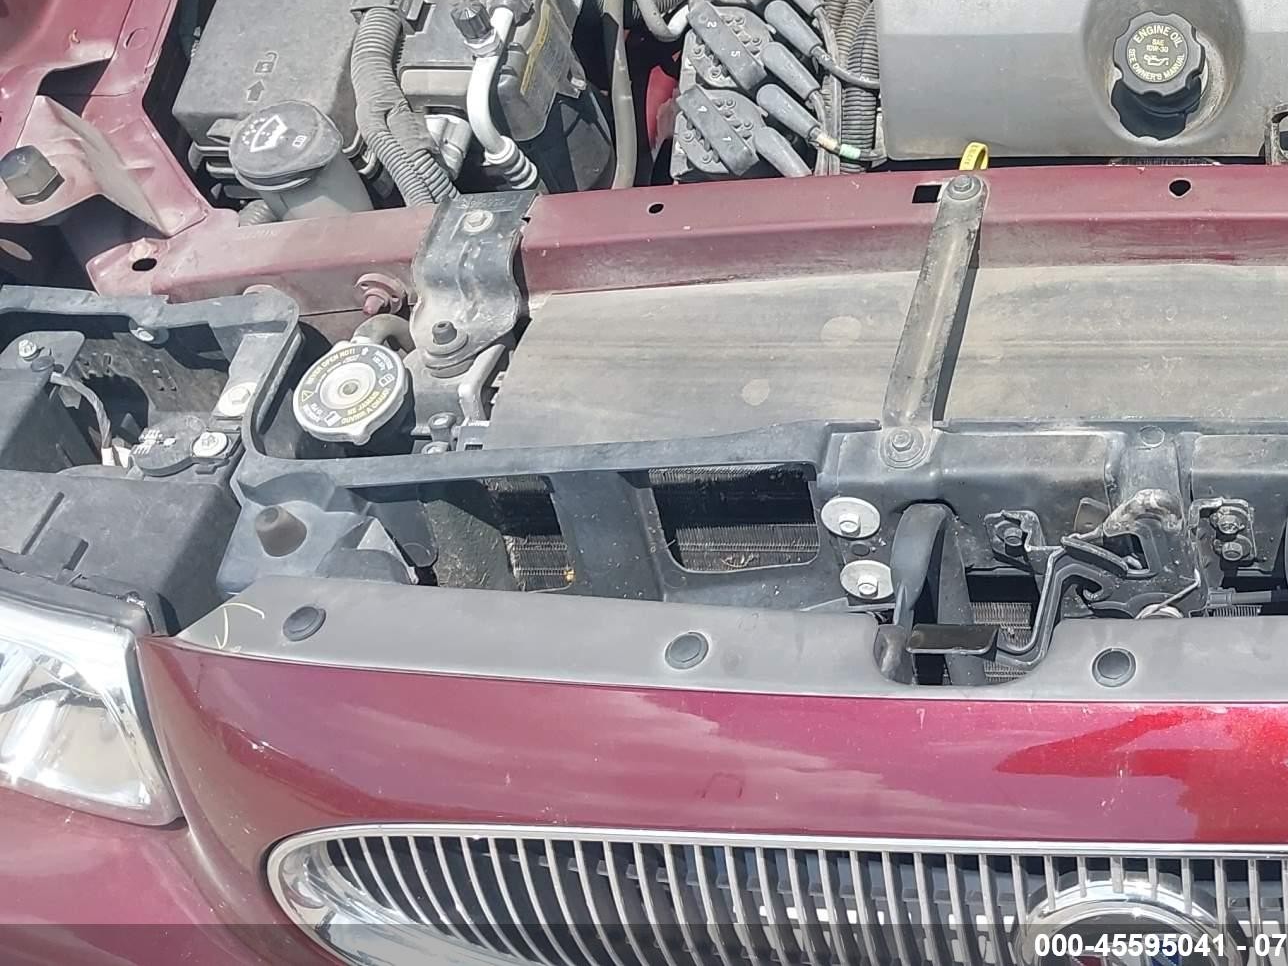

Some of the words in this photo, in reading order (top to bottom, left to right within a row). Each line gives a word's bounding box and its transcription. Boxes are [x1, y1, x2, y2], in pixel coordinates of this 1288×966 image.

[1133, 25, 1171, 43] ENGINE
[1170, 32, 1183, 48] OIL
[1151, 38, 1165, 46] SAE
[1128, 48, 1136, 64] SEE
[1132, 63, 1163, 81] OWNER'S
[1163, 53, 1185, 80] MANUAL
[322, 354, 339, 368] OPEN
[340, 348, 356, 359] HOT!
